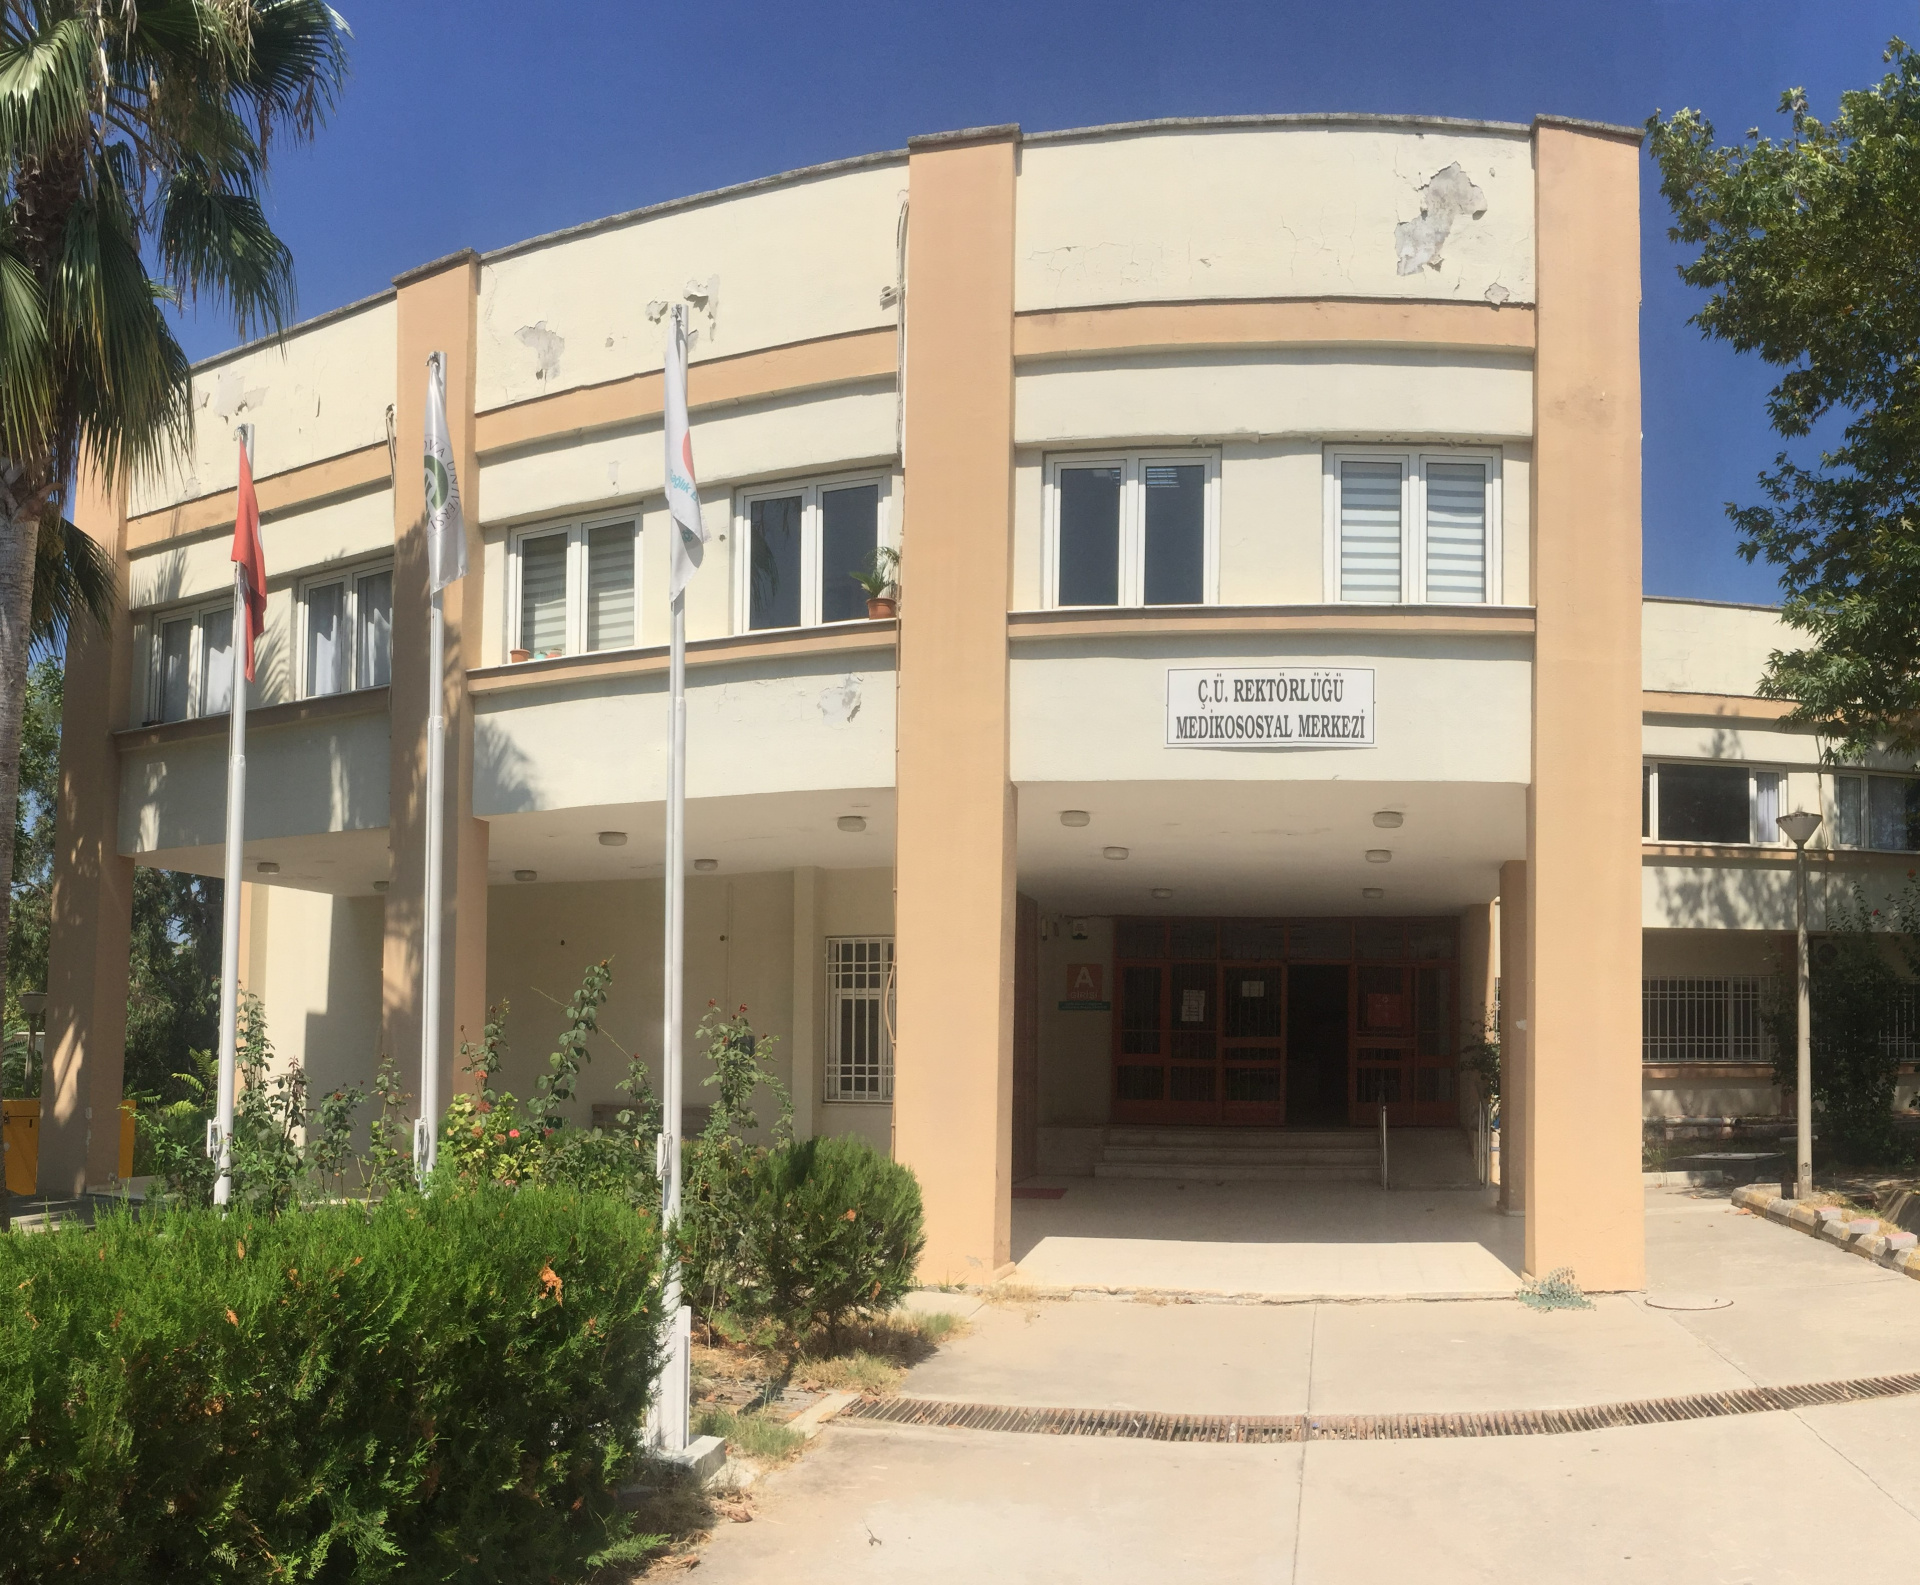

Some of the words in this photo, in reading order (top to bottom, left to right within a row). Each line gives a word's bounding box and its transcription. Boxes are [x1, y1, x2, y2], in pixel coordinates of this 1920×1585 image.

[1198, 673, 1228, 709] Ç.Ü.
[1233, 672, 1344, 703] REKTÖRLÜĞÜ
[1176, 709, 1293, 739] MEDİKOSOSYAL
[1298, 709, 1365, 739] MERKEZİ
[1074, 966, 1094, 988] A
